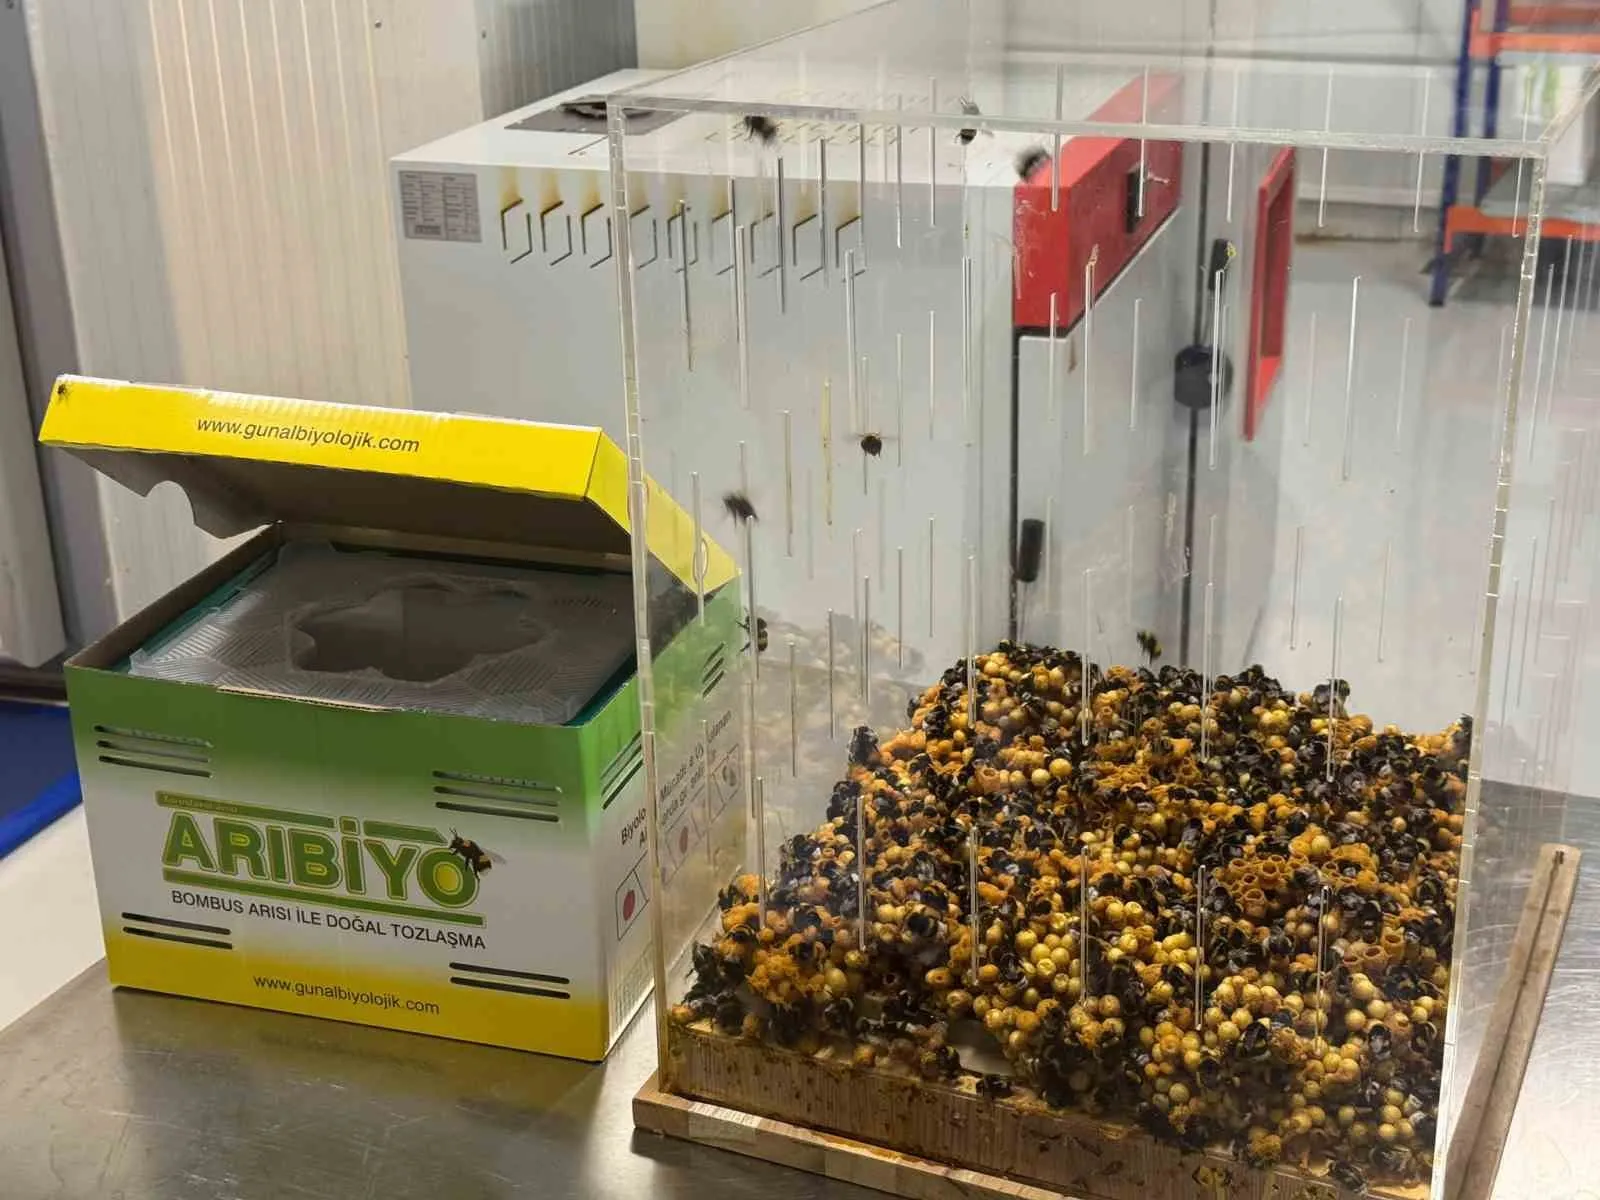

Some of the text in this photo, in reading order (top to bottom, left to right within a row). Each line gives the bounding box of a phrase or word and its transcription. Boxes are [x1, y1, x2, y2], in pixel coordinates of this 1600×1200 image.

[197, 418, 420, 453] www.gunalbiyolojik.com
[161, 809, 480, 909] ARIBİYO
[171, 889, 486, 950] BOMBUS ARISI İLE DOĞAL TOZLAŞMA
[253, 975, 441, 1015] www.gunalbiyolojik.com
